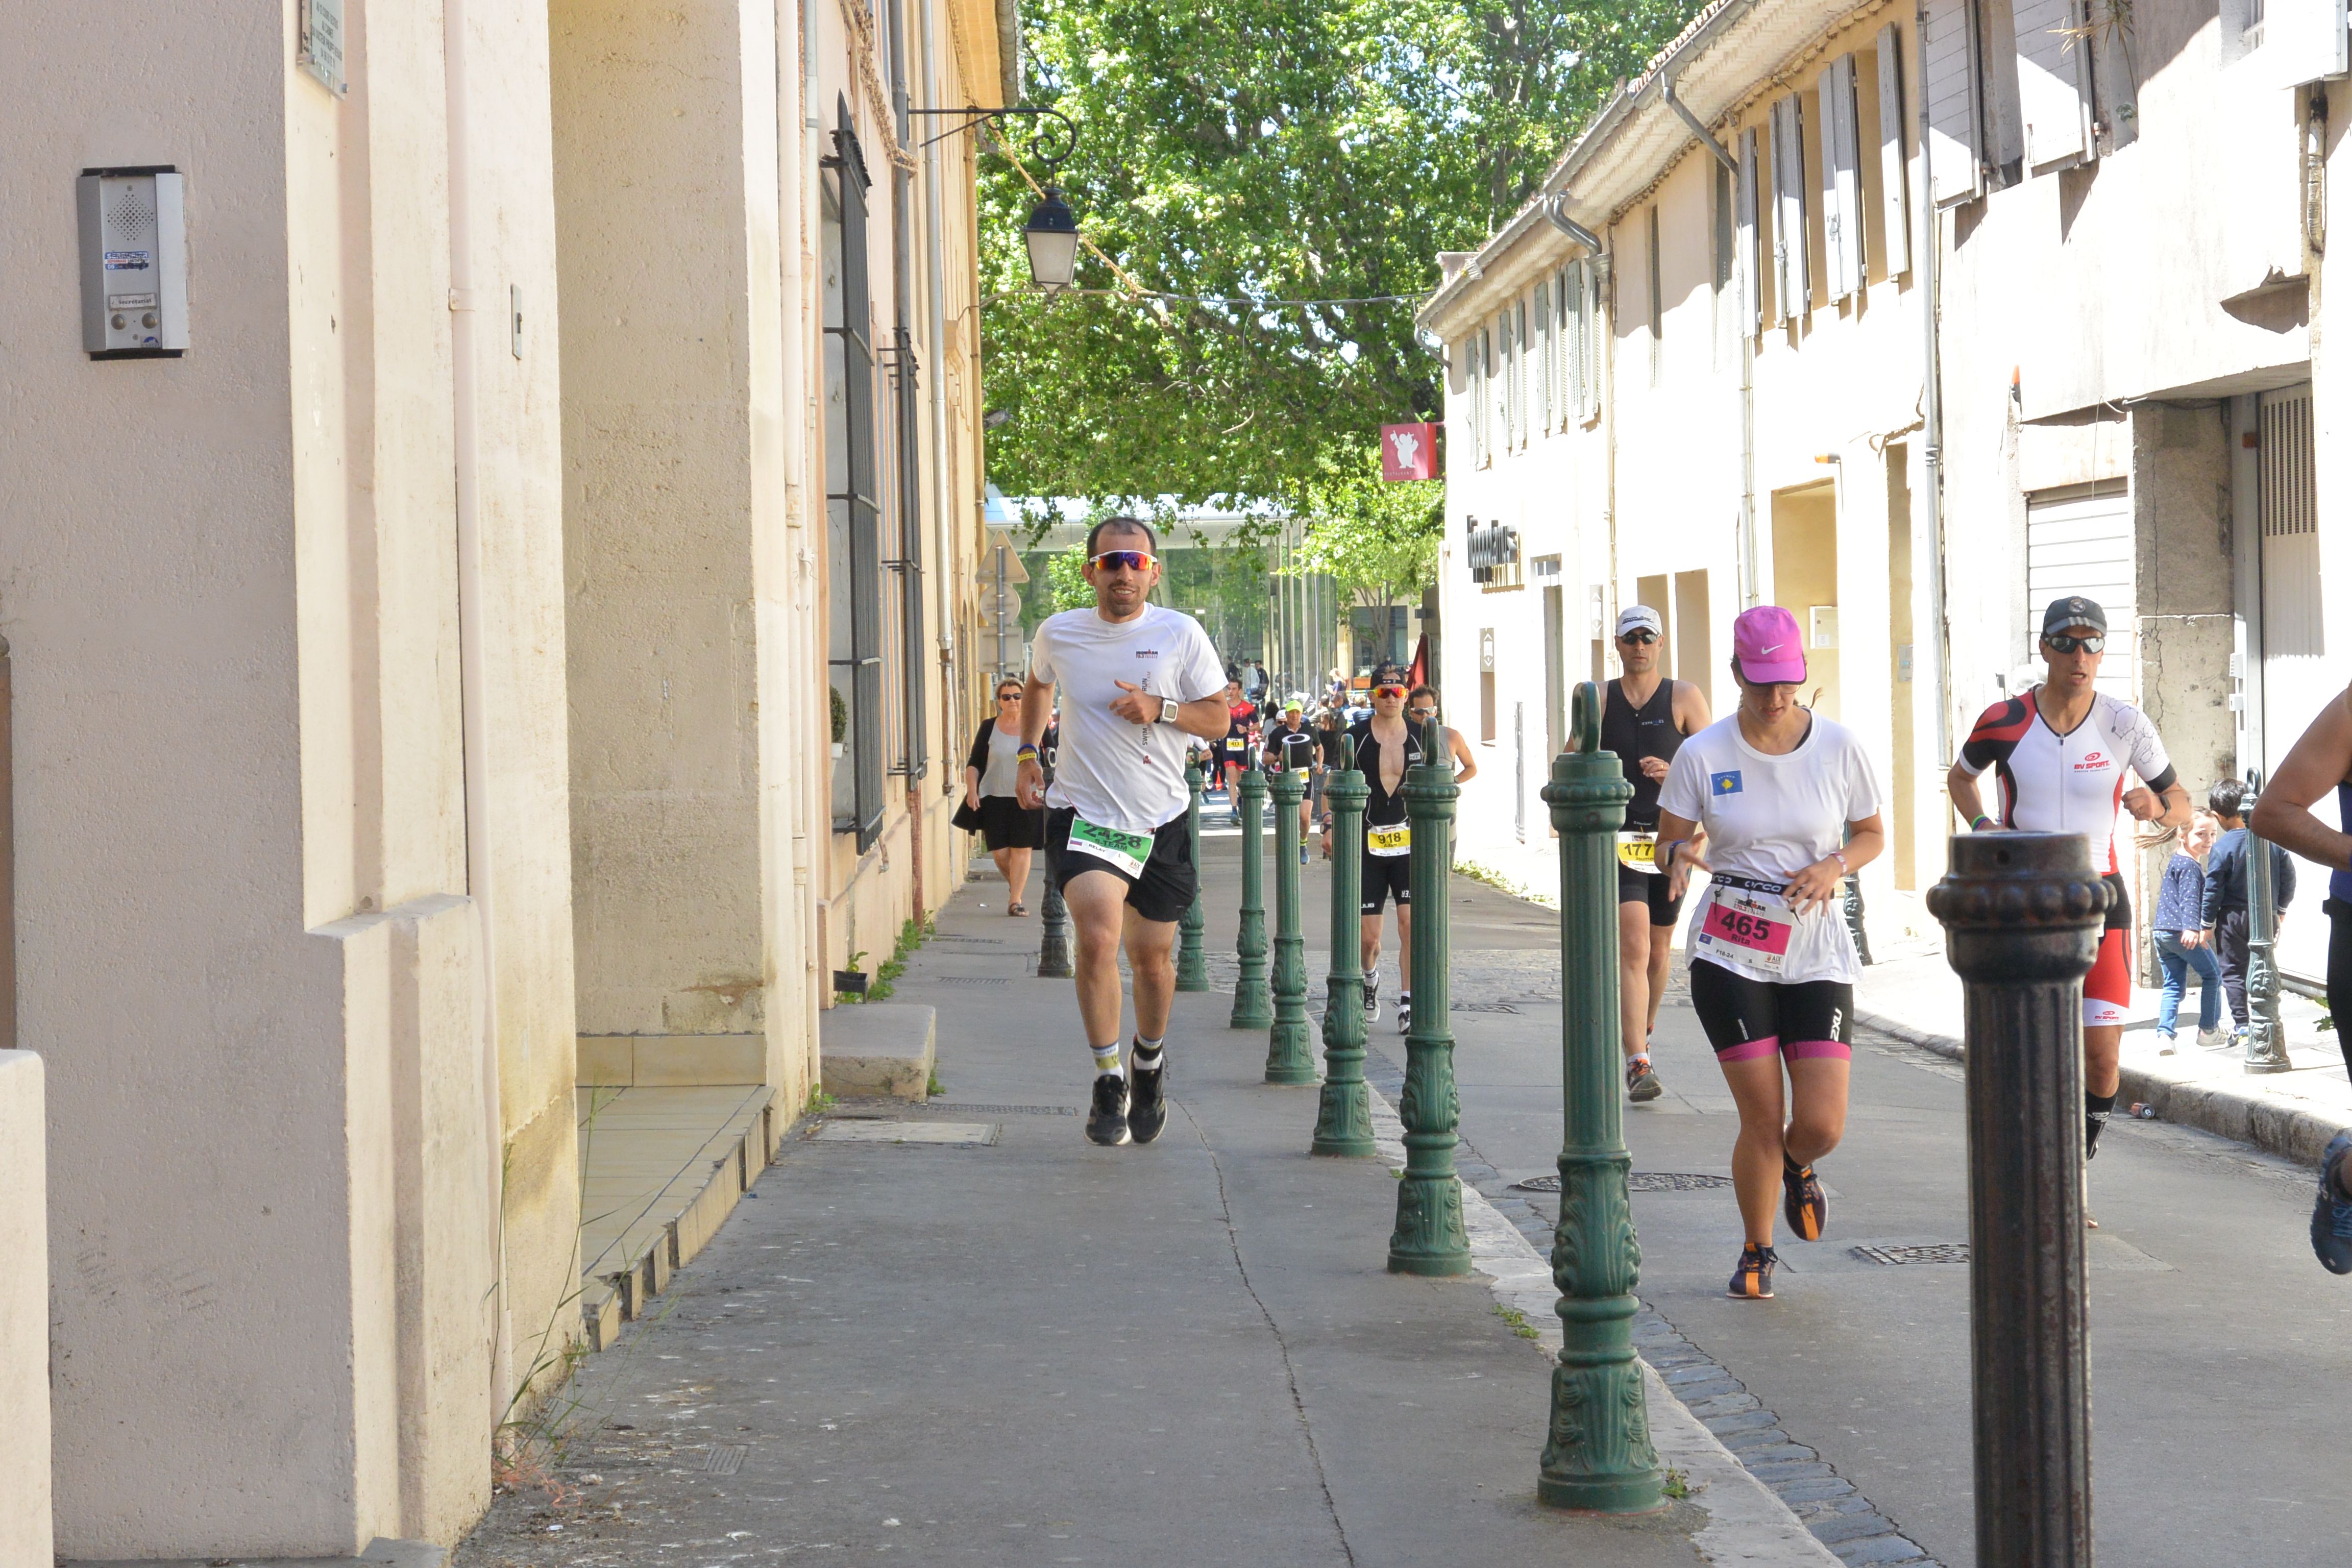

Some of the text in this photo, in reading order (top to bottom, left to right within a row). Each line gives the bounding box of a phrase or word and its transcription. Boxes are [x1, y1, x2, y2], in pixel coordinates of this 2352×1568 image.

[2086, 760, 2110, 769] SPORT
[1083, 823, 1142, 850] 2428
[1378, 832, 1401, 844] 918
[1089, 844, 1106, 852] RELAY
[1624, 844, 1655, 855] 177
[1745, 881, 1782, 892] orca
[1721, 912, 1770, 940] 465
[1731, 934, 1750, 945] Rita
[1716, 949, 1734, 959] F18-24
[1830, 1008, 1843, 1042] 2XU
